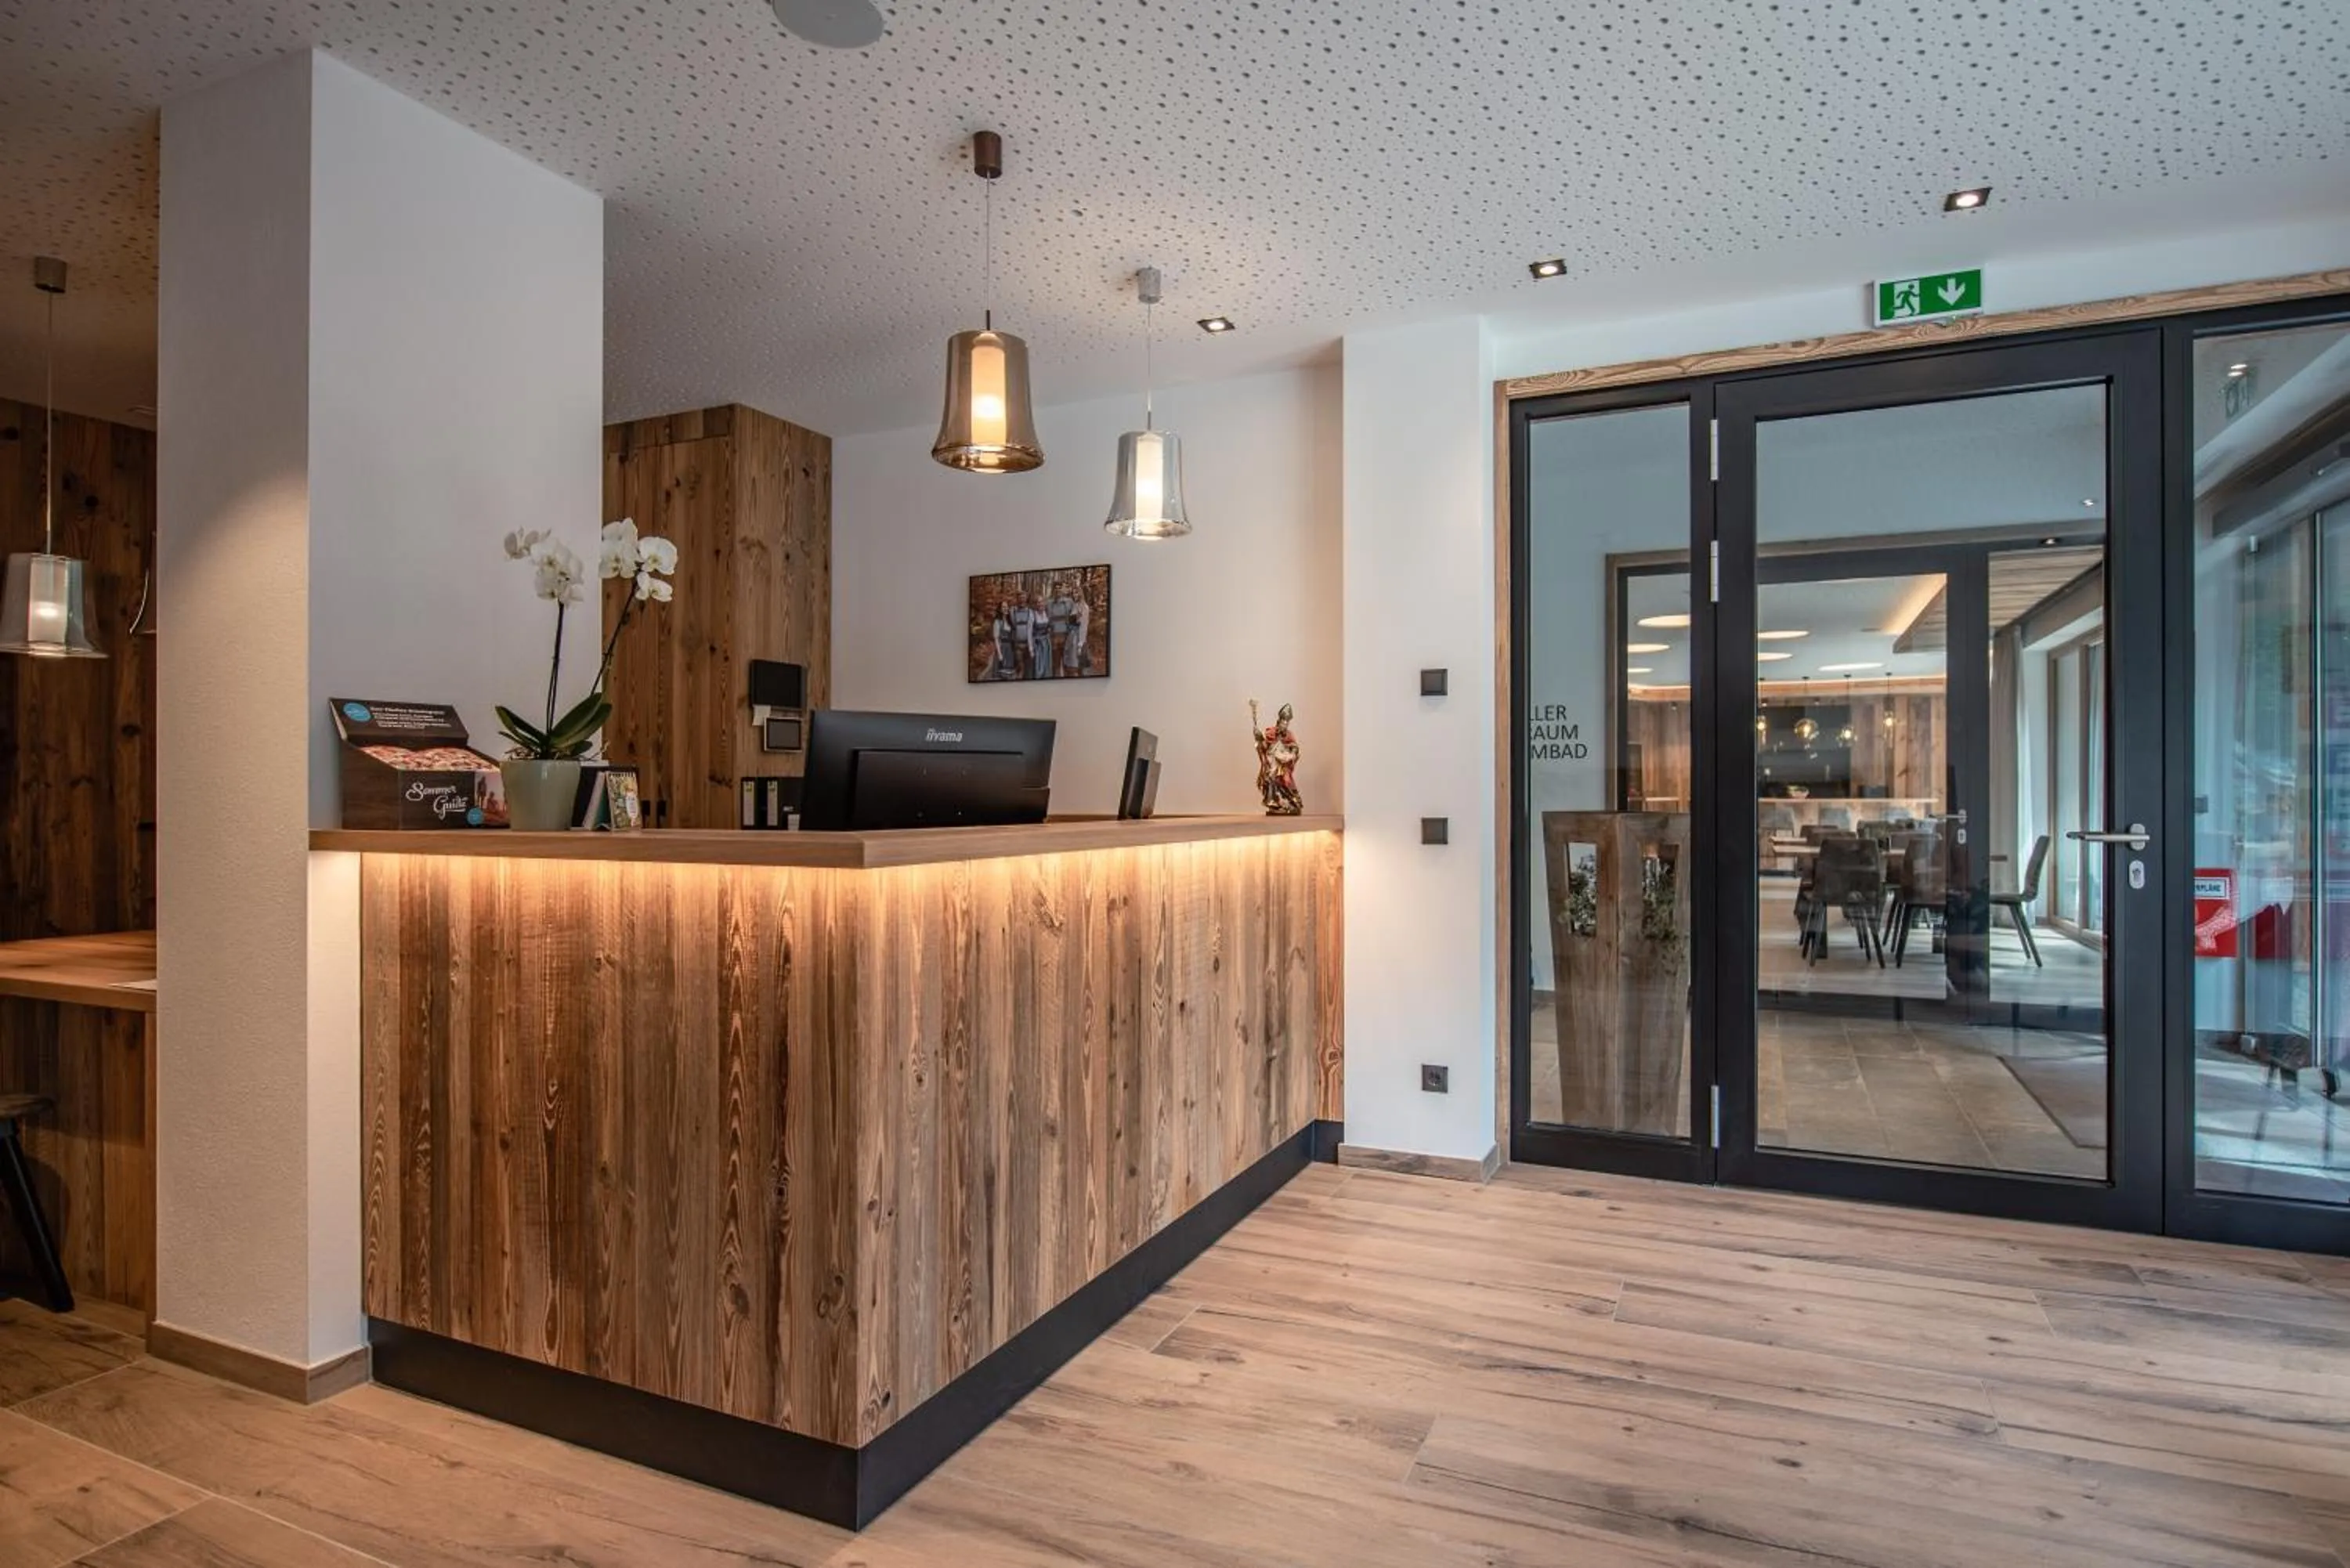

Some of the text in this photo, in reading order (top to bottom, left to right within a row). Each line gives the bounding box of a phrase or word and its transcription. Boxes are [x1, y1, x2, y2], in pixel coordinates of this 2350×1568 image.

[1530, 704, 1567, 721] LER
[1530, 724, 1578, 740] AUM
[1531, 743, 1588, 759] MBAD
[405, 782, 457, 801] Sommer
